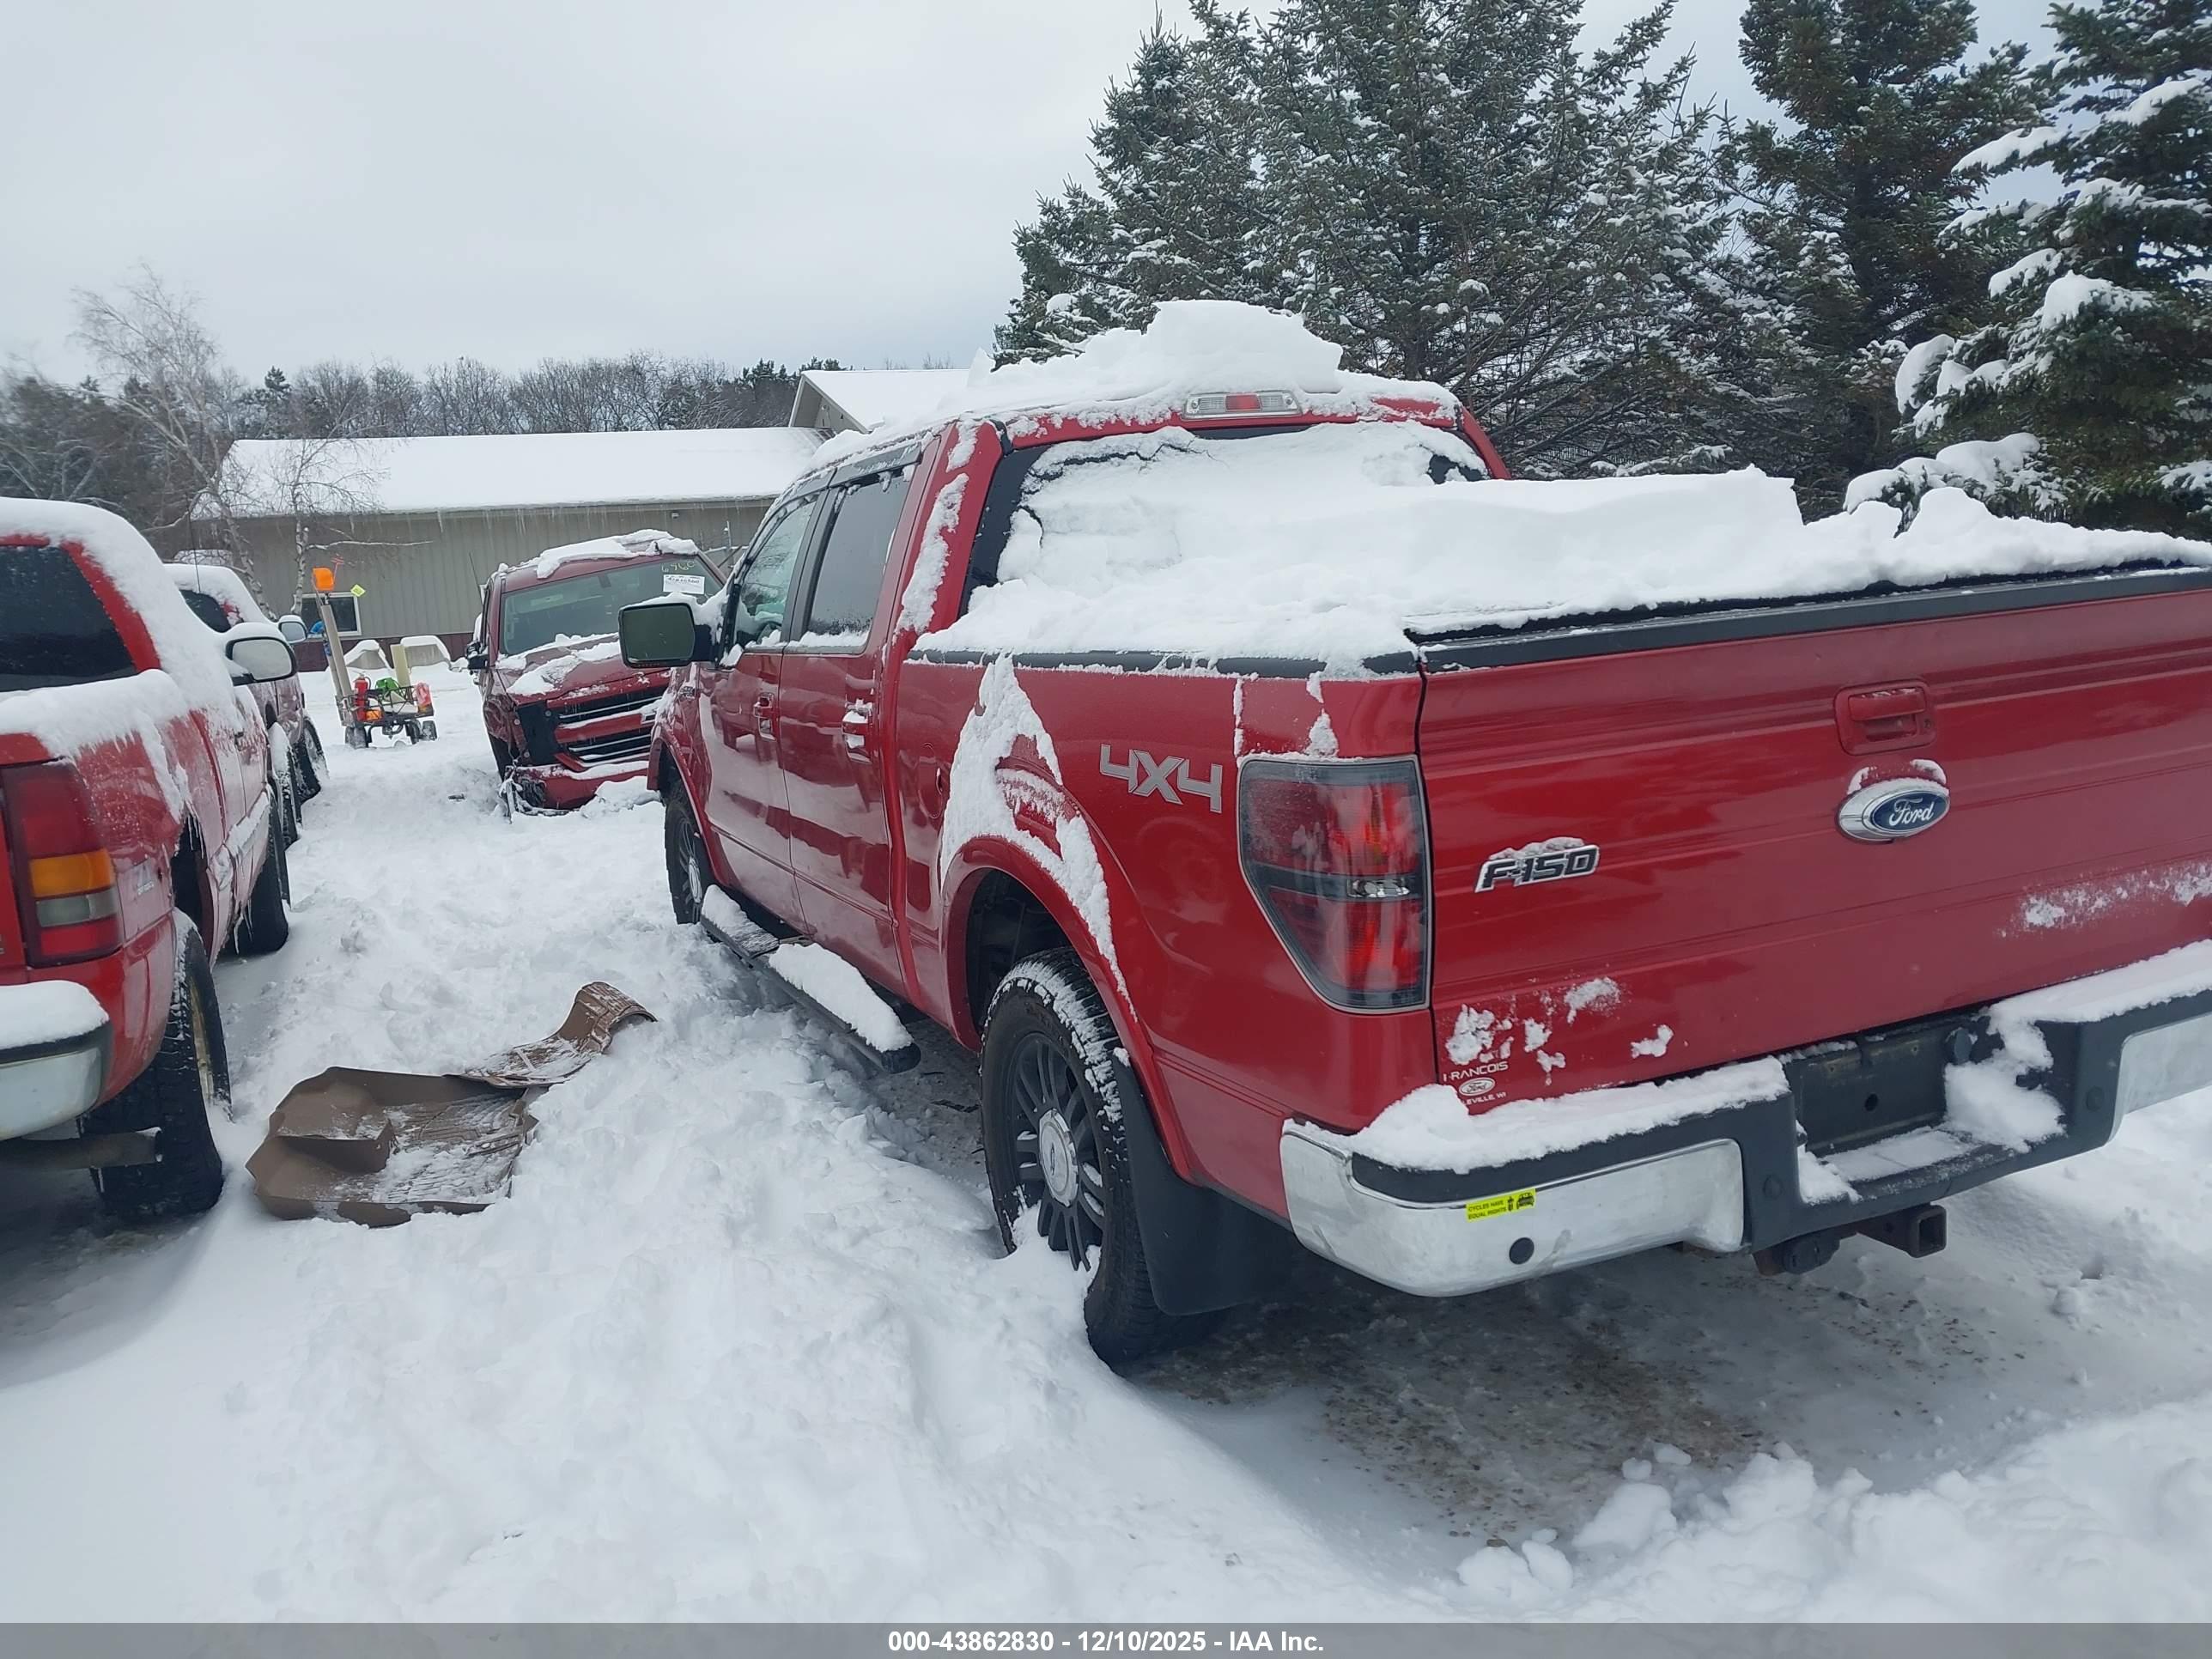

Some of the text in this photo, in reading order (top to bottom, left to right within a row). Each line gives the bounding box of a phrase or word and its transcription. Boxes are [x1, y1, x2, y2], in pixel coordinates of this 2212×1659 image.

[1099, 744, 1223, 813] 4X4
[1889, 798, 1935, 826] Ford
[1474, 845, 1600, 893] F-150
